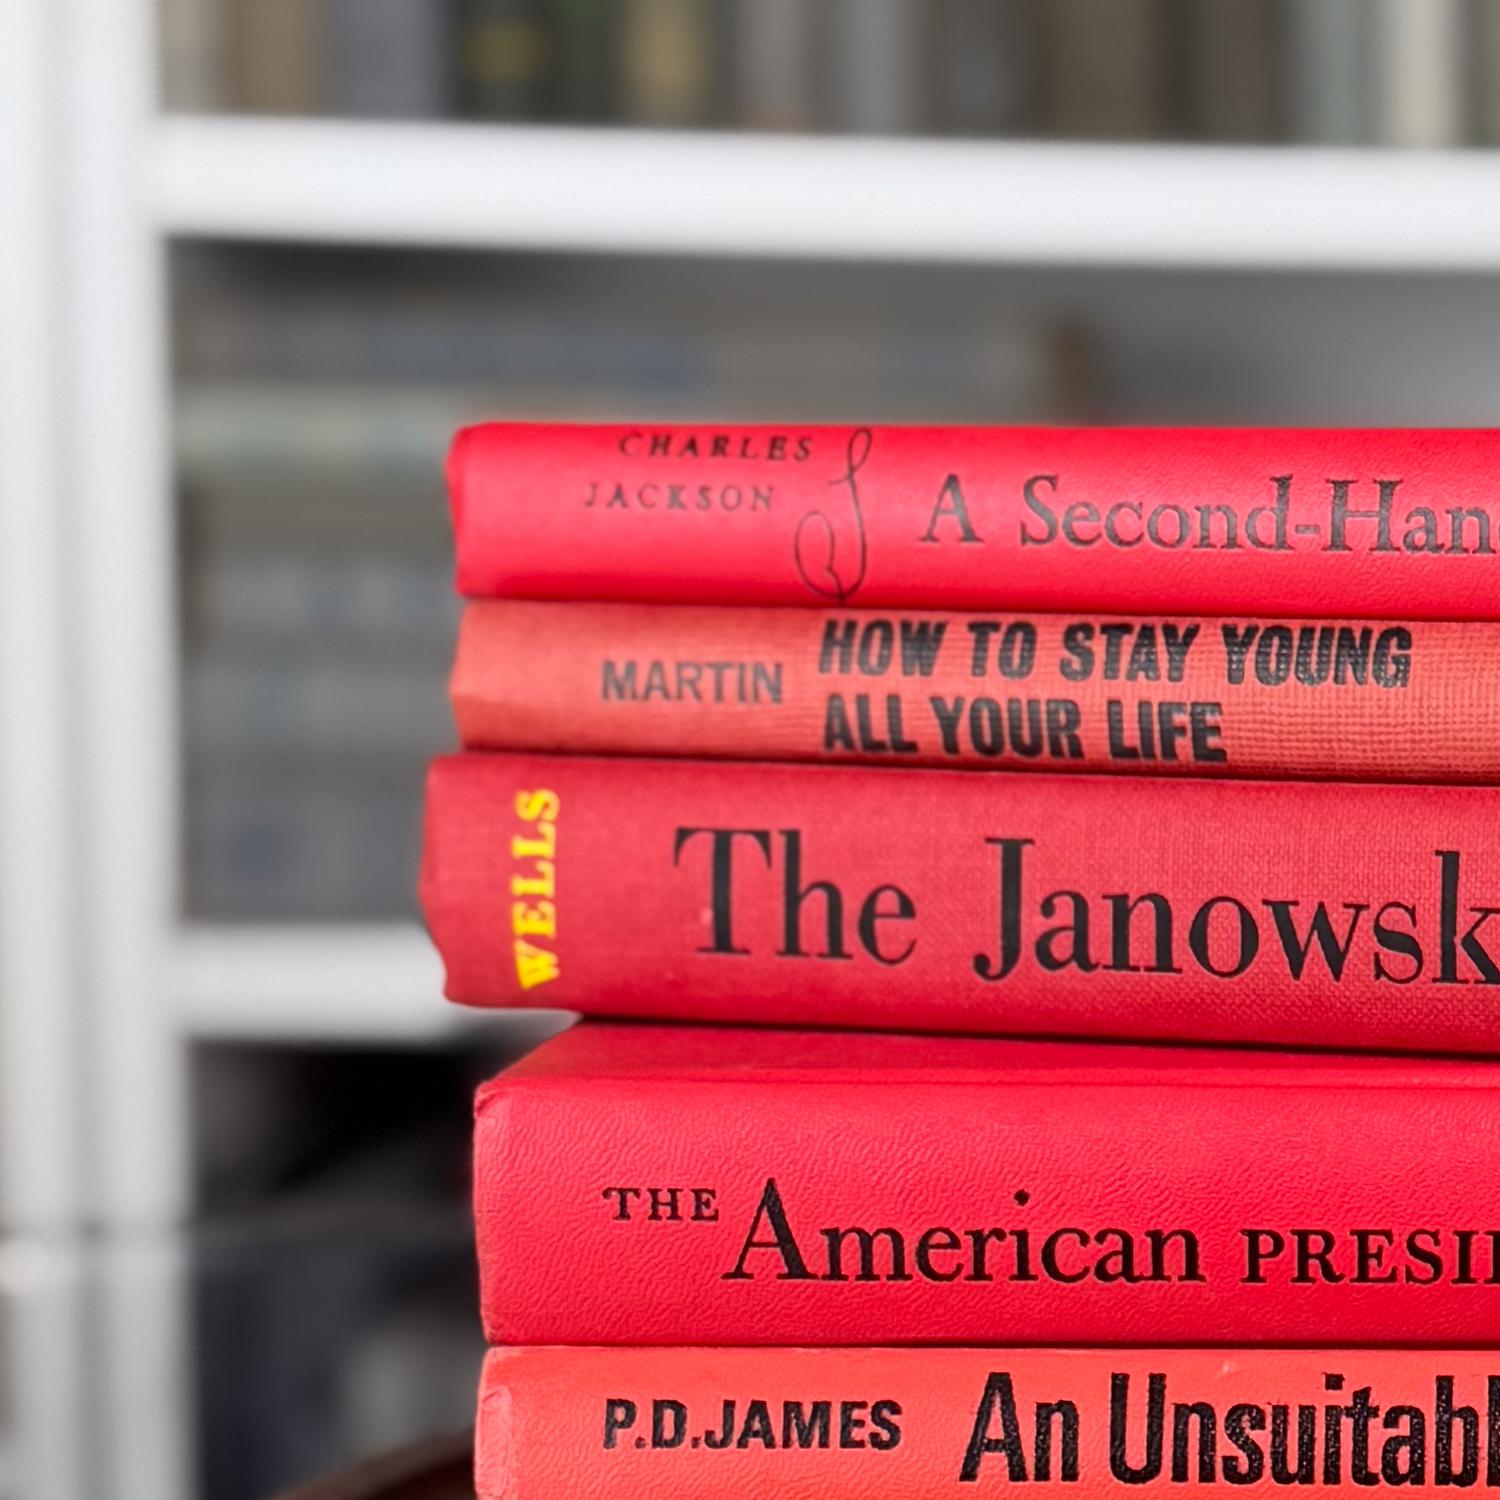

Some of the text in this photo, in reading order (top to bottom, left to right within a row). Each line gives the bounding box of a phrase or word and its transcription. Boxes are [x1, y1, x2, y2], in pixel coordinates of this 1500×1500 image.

[618, 430, 813, 462] CHARLES
[583, 482, 776, 513] JACKSON
[918, 472, 984, 544] A
[601, 658, 784, 704] MARTIN
[818, 618, 1413, 689] HOW TO STAY YOUNG
[823, 693, 1227, 763] ALL YOUR LIFE
[511, 788, 560, 992] WELLS
[672, 825, 918, 966] The
[602, 1186, 720, 1223] THE
[720, 1176, 1208, 1284] American
[958, 1371, 1080, 1484] An
